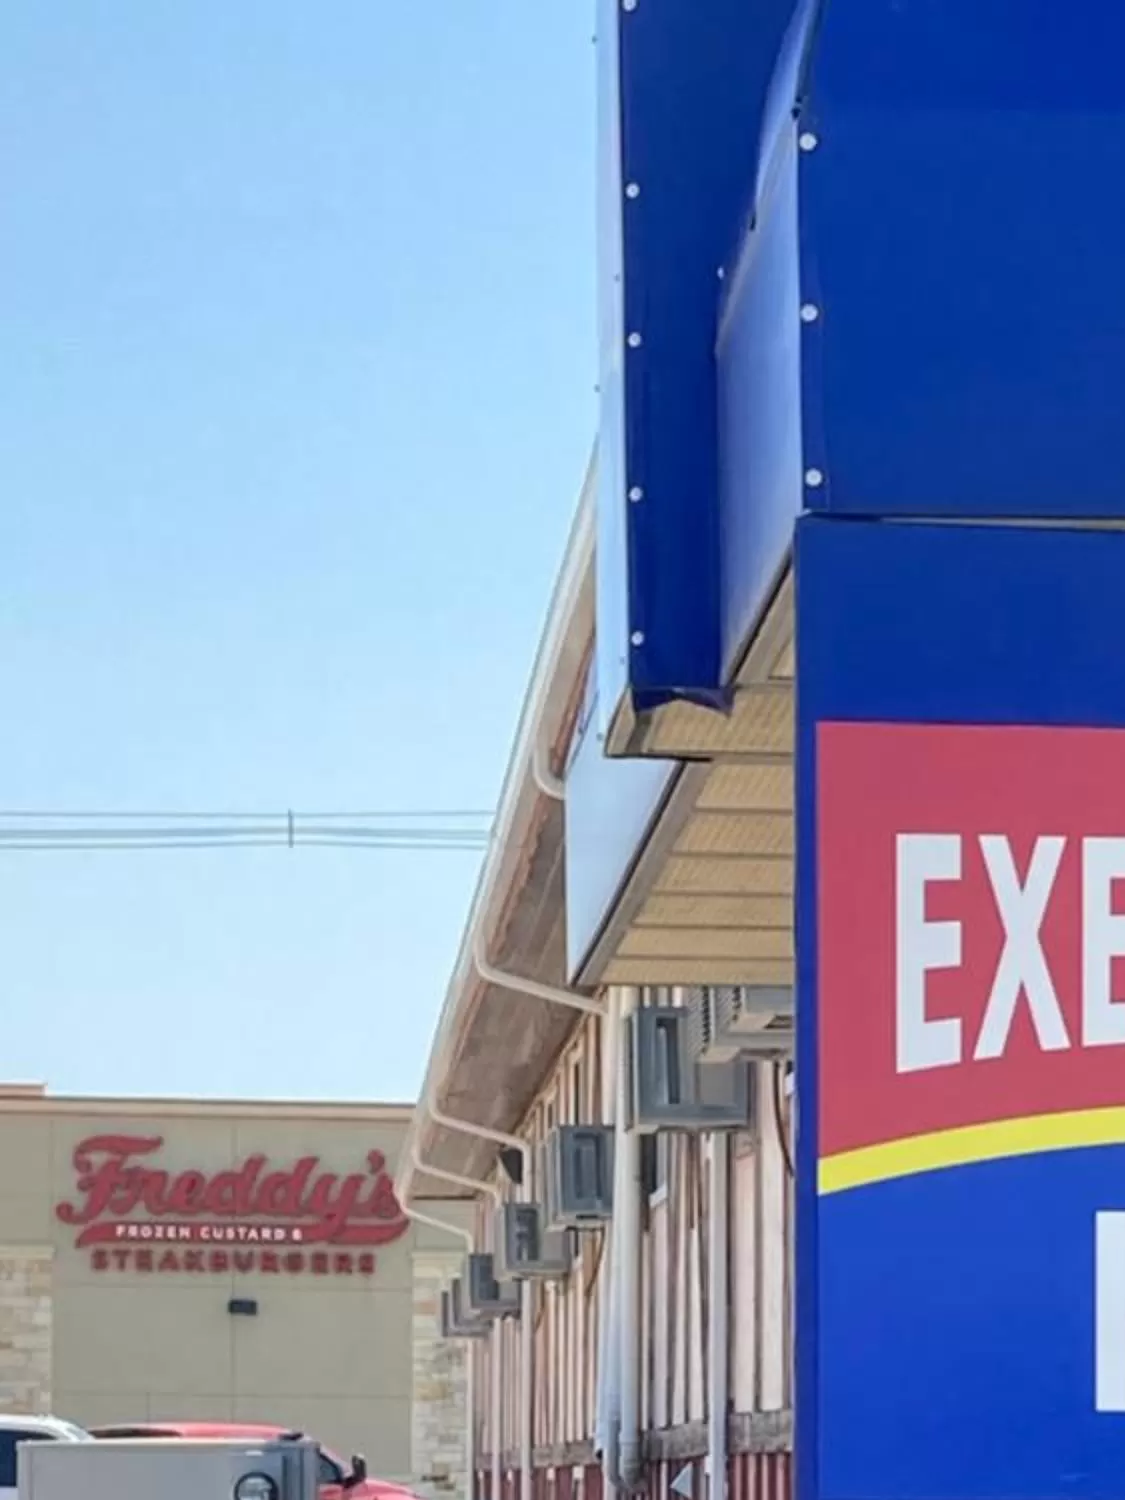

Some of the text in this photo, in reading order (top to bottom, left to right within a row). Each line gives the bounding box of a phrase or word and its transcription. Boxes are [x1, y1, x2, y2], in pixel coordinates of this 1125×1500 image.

[55, 1135, 404, 1236] Freddy's
[115, 1223, 191, 1241] FROZEN
[199, 1224, 286, 1242] CUSTARD
[91, 1248, 376, 1276] STEAKBURGERS
